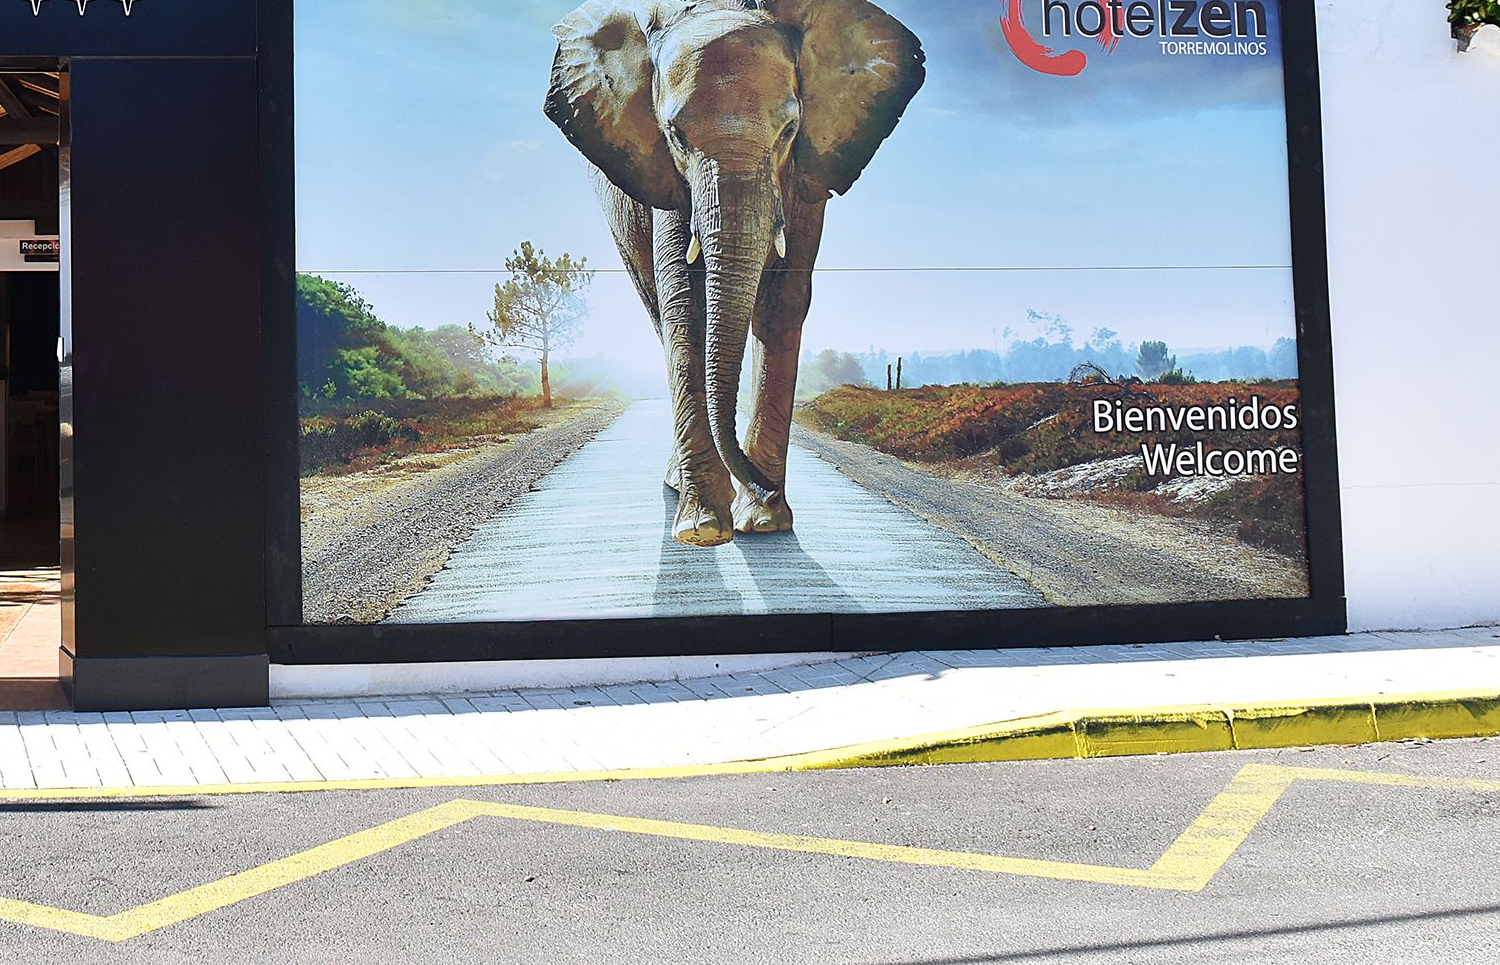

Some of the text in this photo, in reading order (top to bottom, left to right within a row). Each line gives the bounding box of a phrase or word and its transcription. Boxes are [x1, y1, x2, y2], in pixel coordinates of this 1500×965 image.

[1159, 41, 1268, 56] TORREMOLINOS
[1092, 396, 1298, 432] Bienvenidos
[1141, 442, 1298, 476] Welcome
